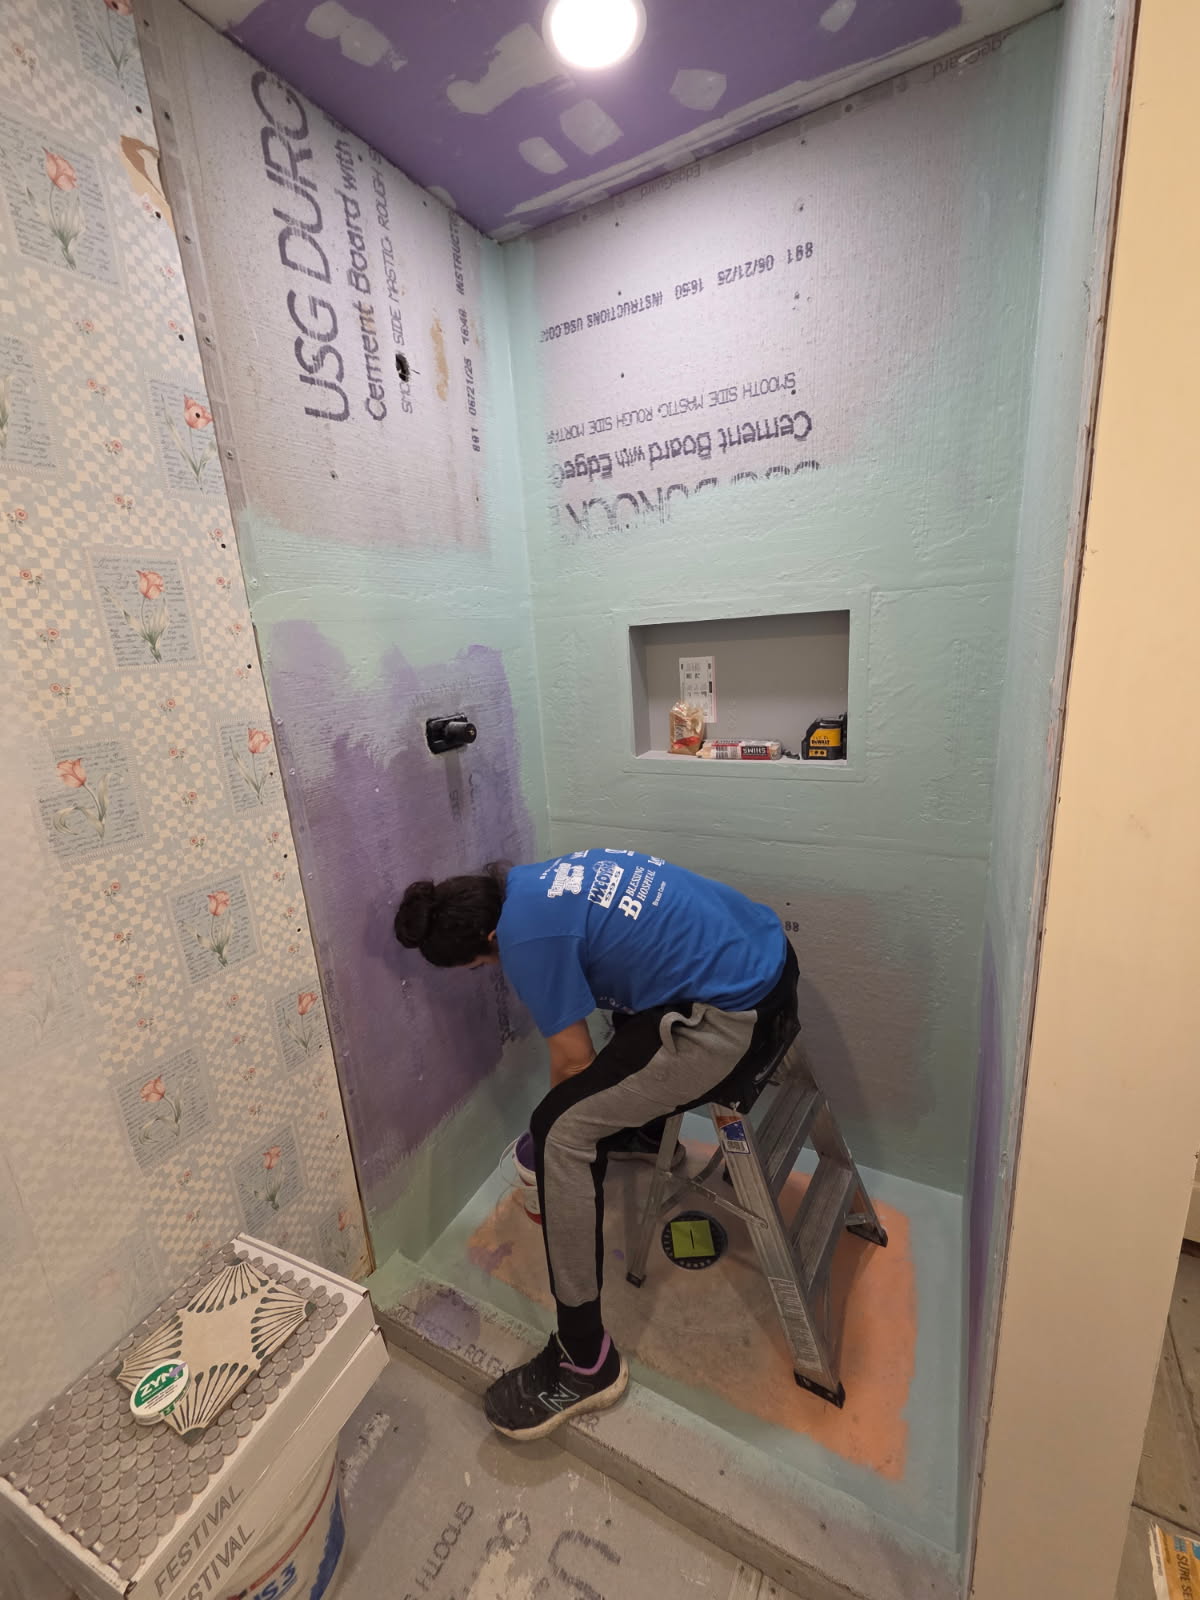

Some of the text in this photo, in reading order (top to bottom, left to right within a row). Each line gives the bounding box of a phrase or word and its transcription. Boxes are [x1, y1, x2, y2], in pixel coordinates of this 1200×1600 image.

[334, 139, 357, 191] with
[371, 167, 392, 231] ROUGH
[251, 70, 350, 422] USG DURO
[334, 188, 371, 295] Board
[717, 254, 774, 286] 06/21/25
[587, 290, 663, 322] INSTRUCTIONS
[390, 306, 405, 346] SIDE
[353, 299, 387, 421] Cement
[709, 387, 738, 407] SIDE
[743, 372, 796, 399] SMOOTH
[588, 416, 613, 435] SIDE
[617, 408, 653, 429] ROUGH
[718, 411, 812, 453] Cement
[615, 446, 645, 468] with
[650, 432, 712, 470] Board
[626, 866, 645, 897] BLESSING
[636, 869, 656, 901] HOSPITAL
[140, 1367, 174, 1397] ZYN
[154, 1485, 244, 1597] FESTIVAL
[1176, 1553, 1191, 1582] SURE
